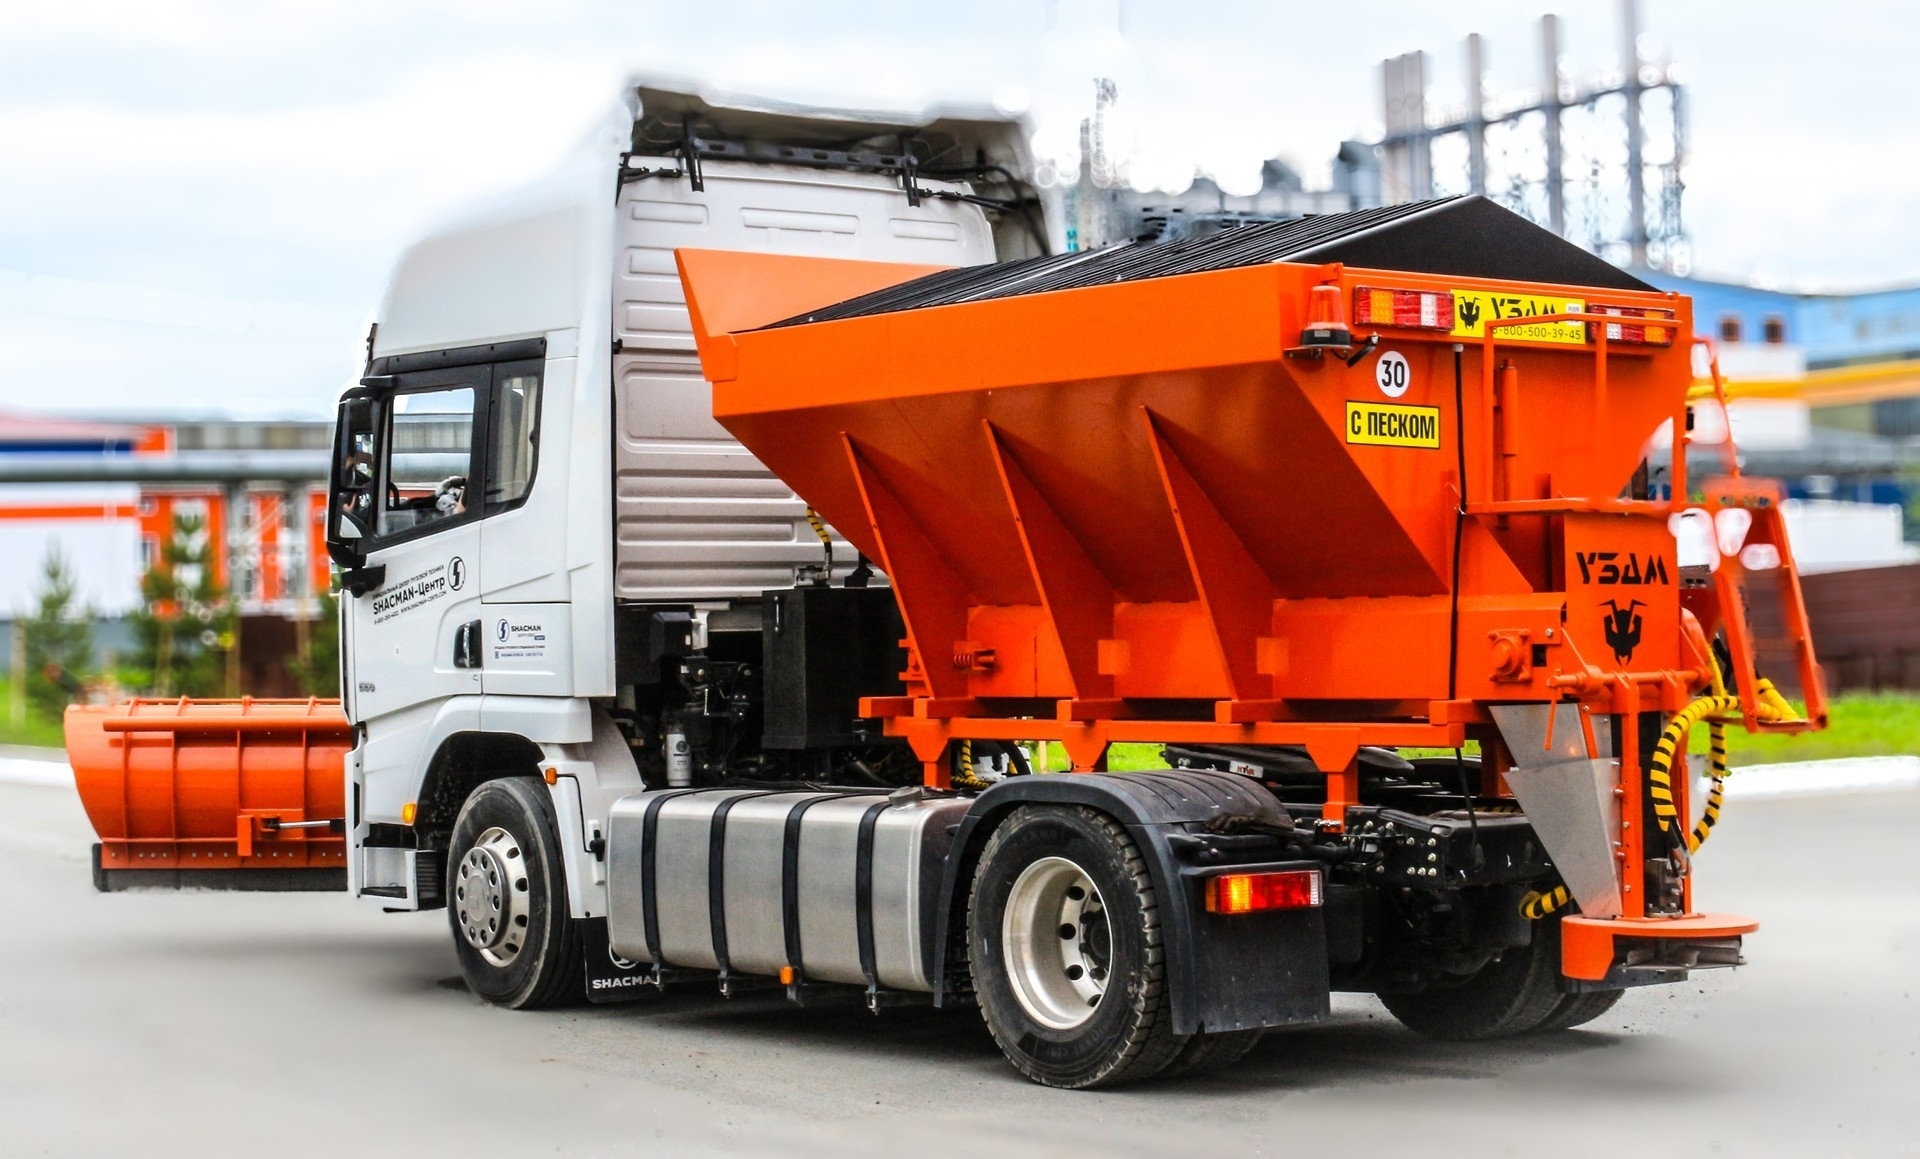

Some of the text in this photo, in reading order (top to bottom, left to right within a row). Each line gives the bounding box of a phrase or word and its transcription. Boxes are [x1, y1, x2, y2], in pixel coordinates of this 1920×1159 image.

[1381, 360, 1405, 388] 30
[1351, 410, 1435, 439] С ПЕСКОМ
[373, 576, 446, 615] SHACMAN-Центр
[592, 976, 653, 989] SHACMA
